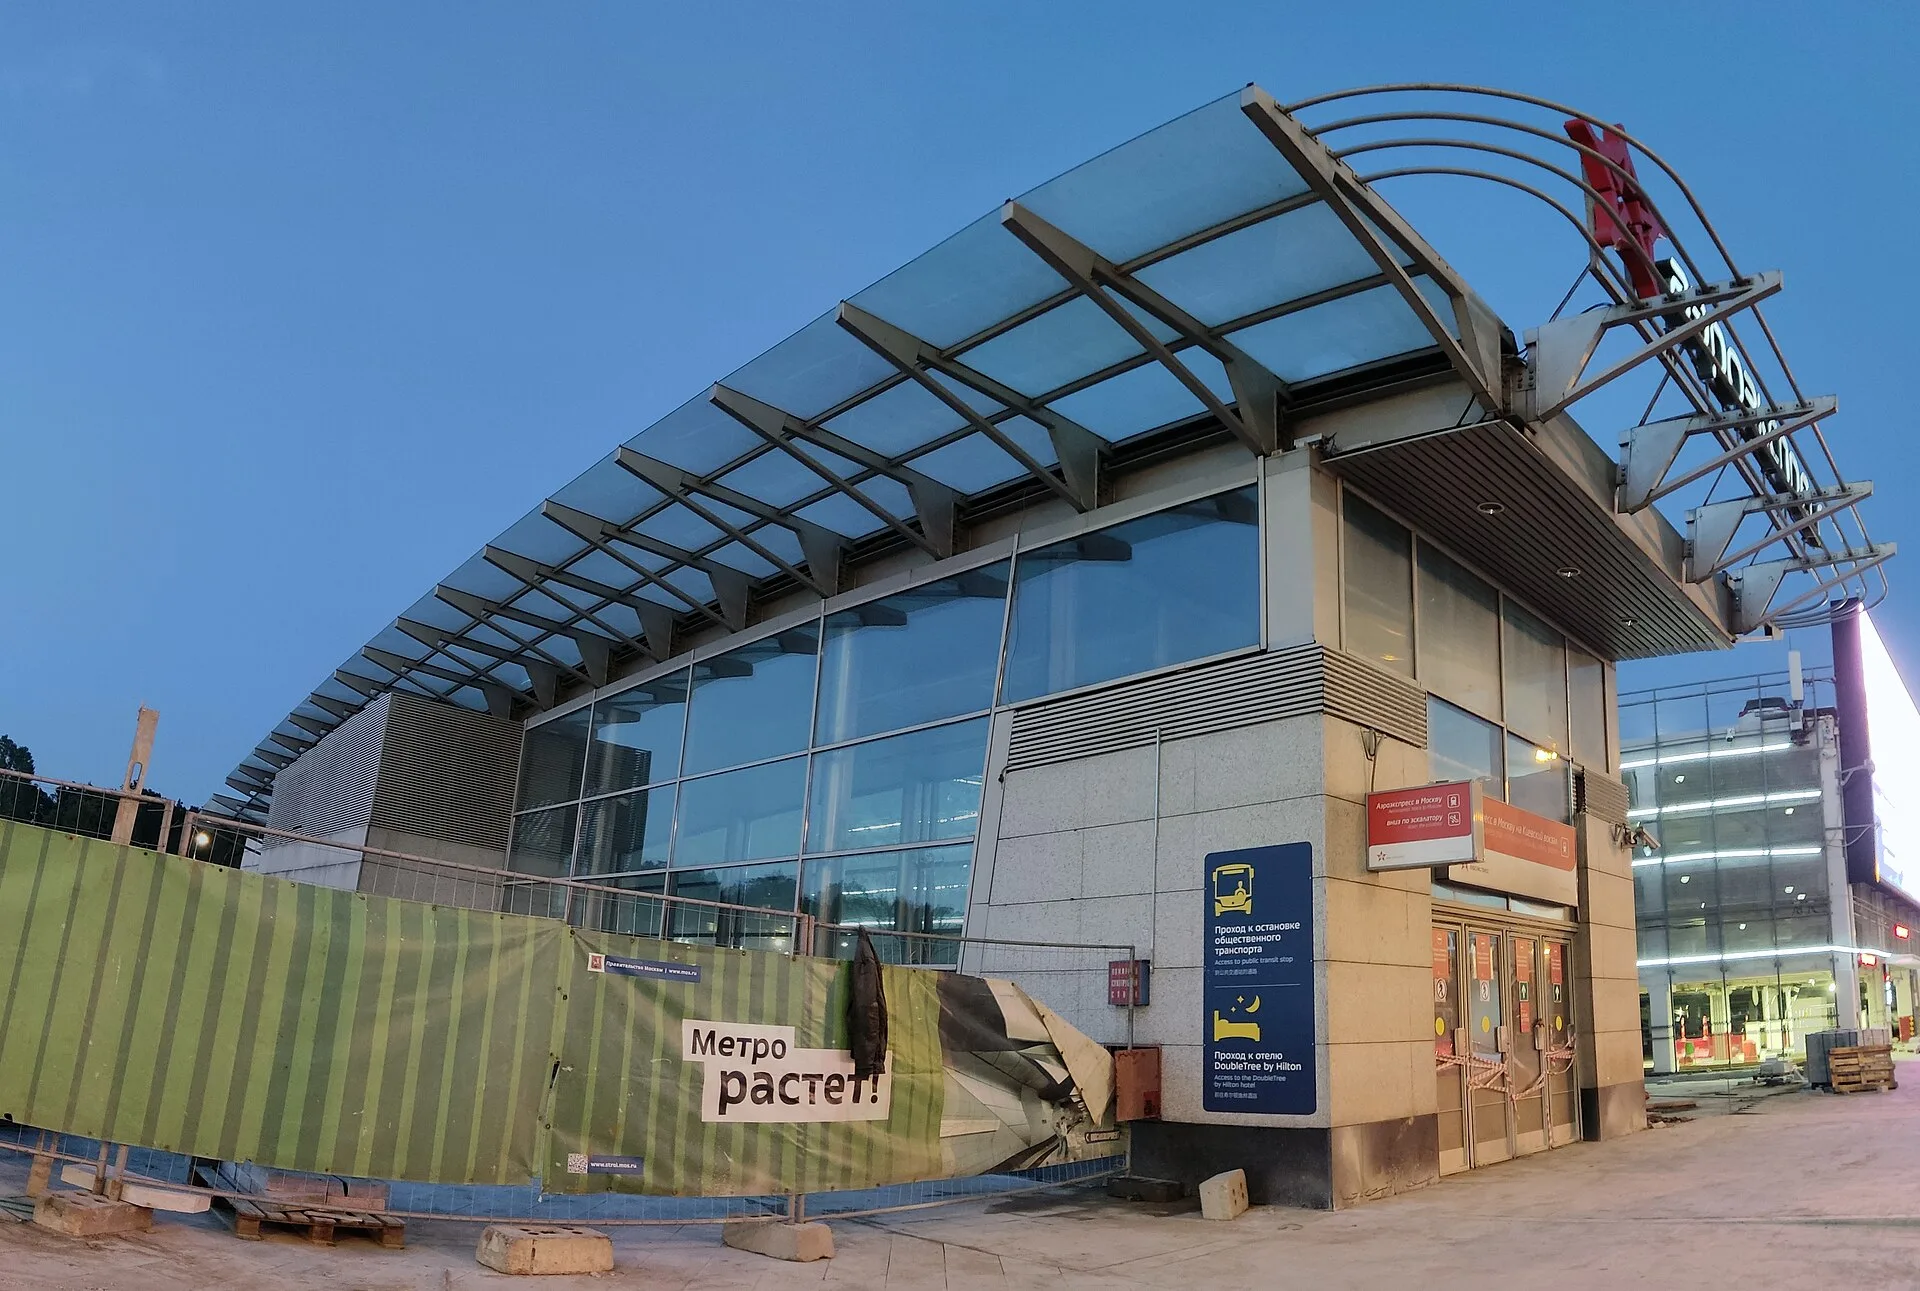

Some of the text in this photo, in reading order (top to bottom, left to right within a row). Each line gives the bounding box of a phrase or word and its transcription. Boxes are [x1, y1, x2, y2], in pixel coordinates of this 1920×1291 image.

[1420, 796, 1443, 804] Москву
[1214, 925, 1246, 935] Проход
[1255, 921, 1301, 932] остановке
[1214, 934, 1281, 945] общественного
[1214, 945, 1263, 956] транспорта
[606, 960, 644, 971] Правительство
[1241, 957, 1259, 965] public
[1259, 956, 1279, 964] transit
[1279, 956, 1294, 964] stop
[691, 1028, 787, 1064] Метро
[1214, 1051, 1246, 1061] Проход
[1255, 1052, 1283, 1060] отелю
[1214, 1061, 1302, 1072] DoubleTree by Hilton
[718, 1069, 880, 1116] растет!
